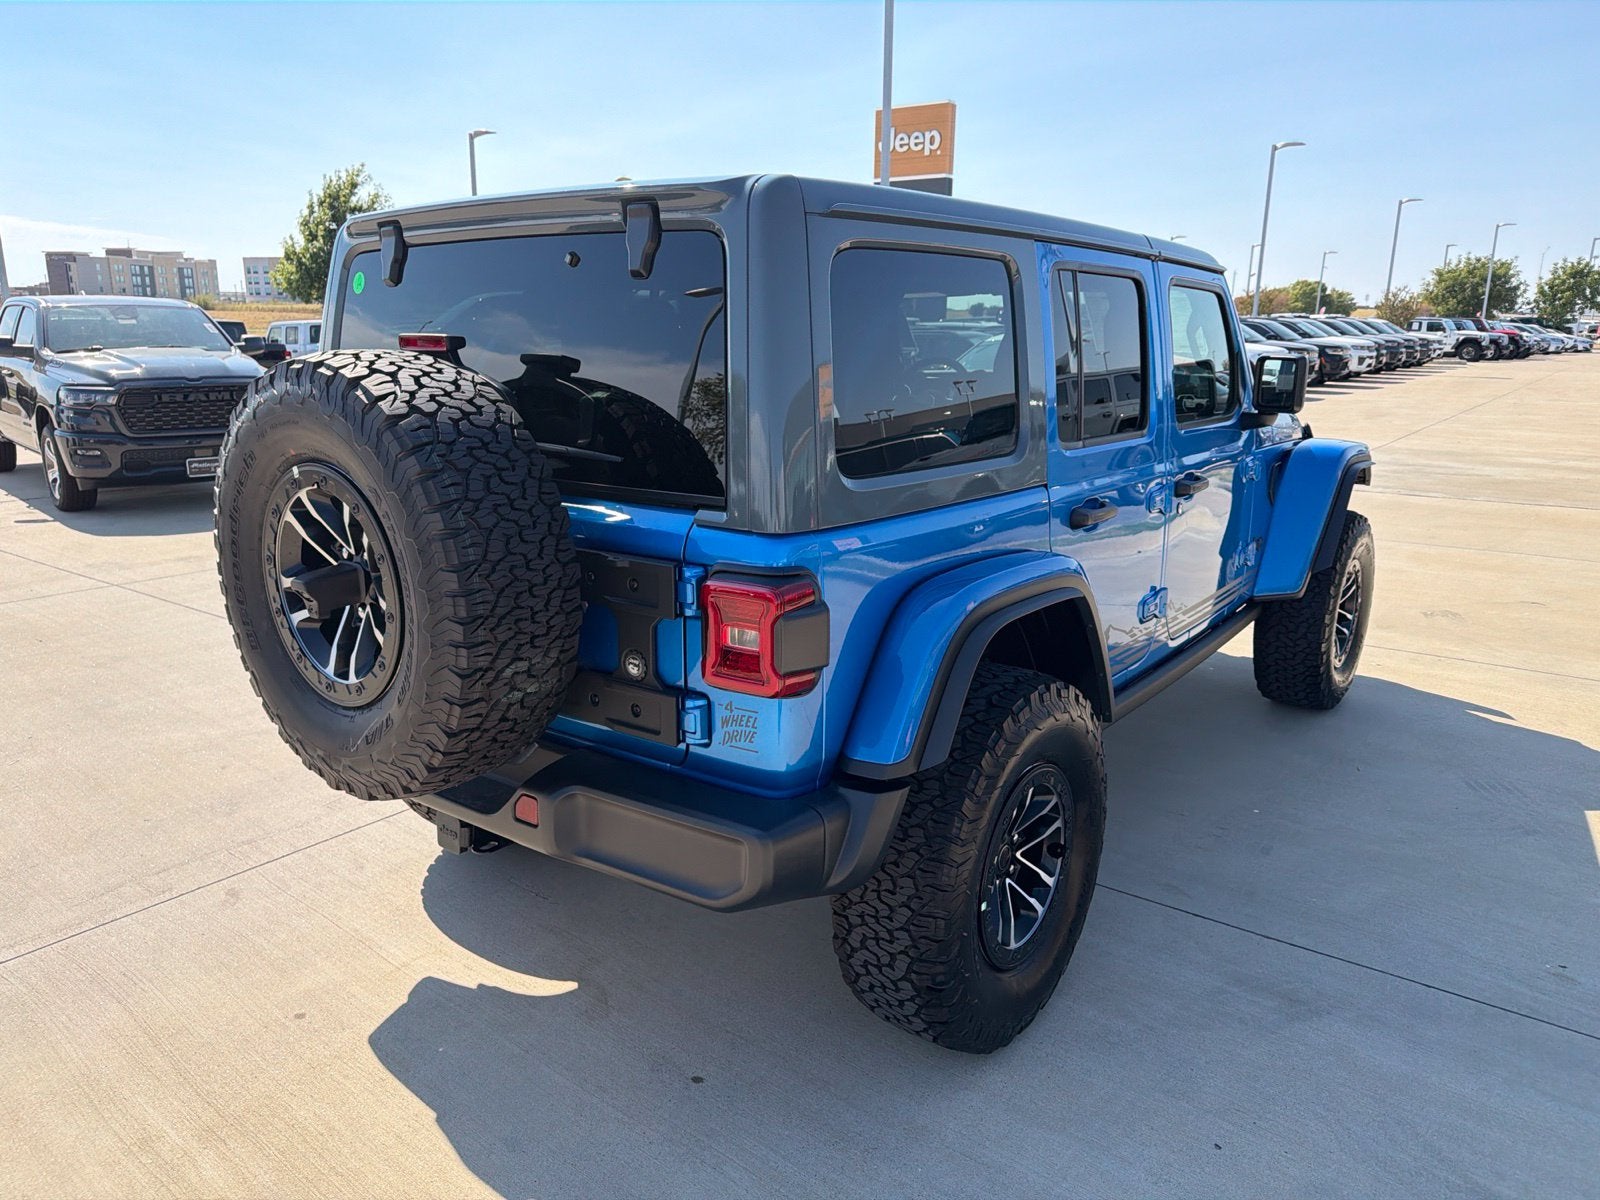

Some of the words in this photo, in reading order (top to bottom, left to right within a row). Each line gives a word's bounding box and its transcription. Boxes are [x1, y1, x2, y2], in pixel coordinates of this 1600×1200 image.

[161, 391, 231, 402] RAM
[724, 701, 734, 713] 4
[721, 714, 758, 730] WHEEL
[722, 729, 758, 746] DRIVE
